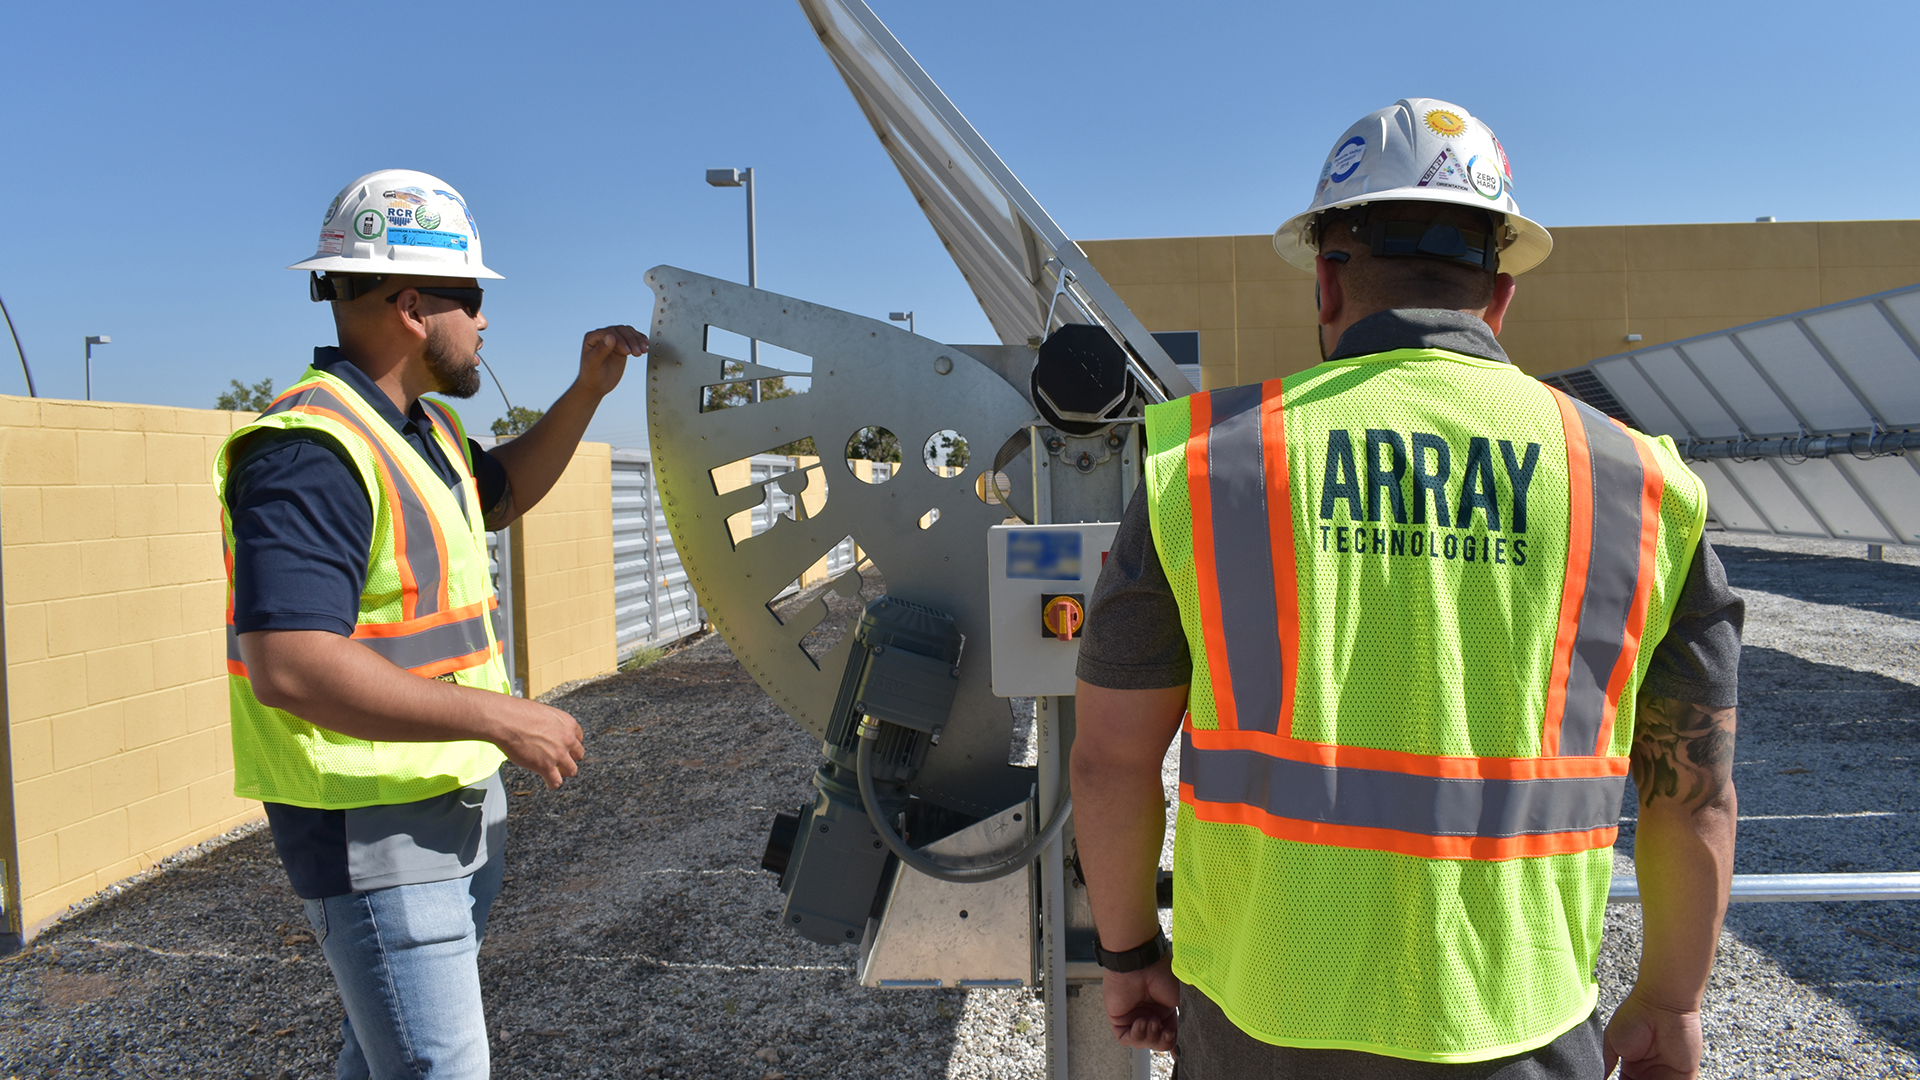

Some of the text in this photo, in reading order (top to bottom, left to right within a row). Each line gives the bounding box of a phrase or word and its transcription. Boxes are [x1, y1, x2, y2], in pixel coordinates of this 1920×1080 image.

[1476, 171, 1496, 184] ZERO
[1436, 182, 1468, 191] ORIENTATION
[1476, 179, 1497, 191] HARM
[388, 208, 413, 218] RCR
[1320, 429, 1541, 534] ARRAY
[1320, 526, 1528, 566] TECHNOLOGIES
